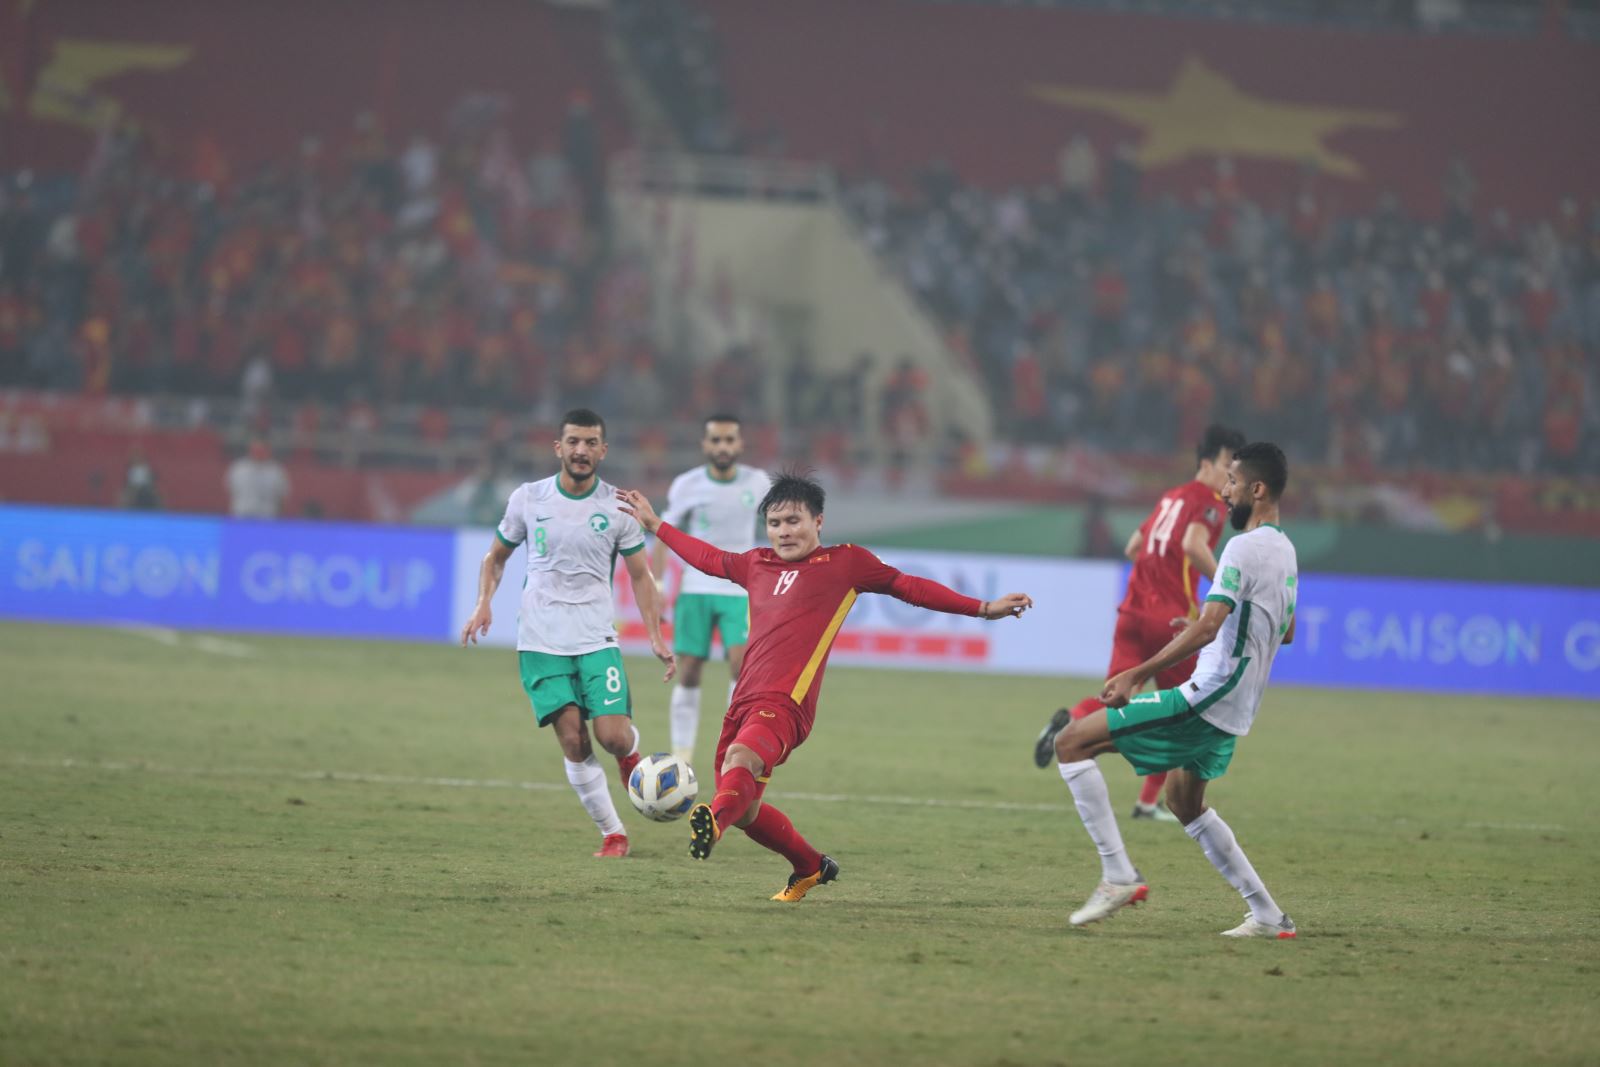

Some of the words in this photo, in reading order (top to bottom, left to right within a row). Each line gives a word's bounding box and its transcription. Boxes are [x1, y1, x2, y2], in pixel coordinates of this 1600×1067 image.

[534, 527, 546, 556] 8
[1147, 497, 1184, 558] 14
[15, 538, 220, 599] SAISON
[241, 549, 435, 611] GROUP
[773, 569, 799, 596] 19
[1342, 607, 1542, 668] SAISON
[606, 666, 621, 693] 8
